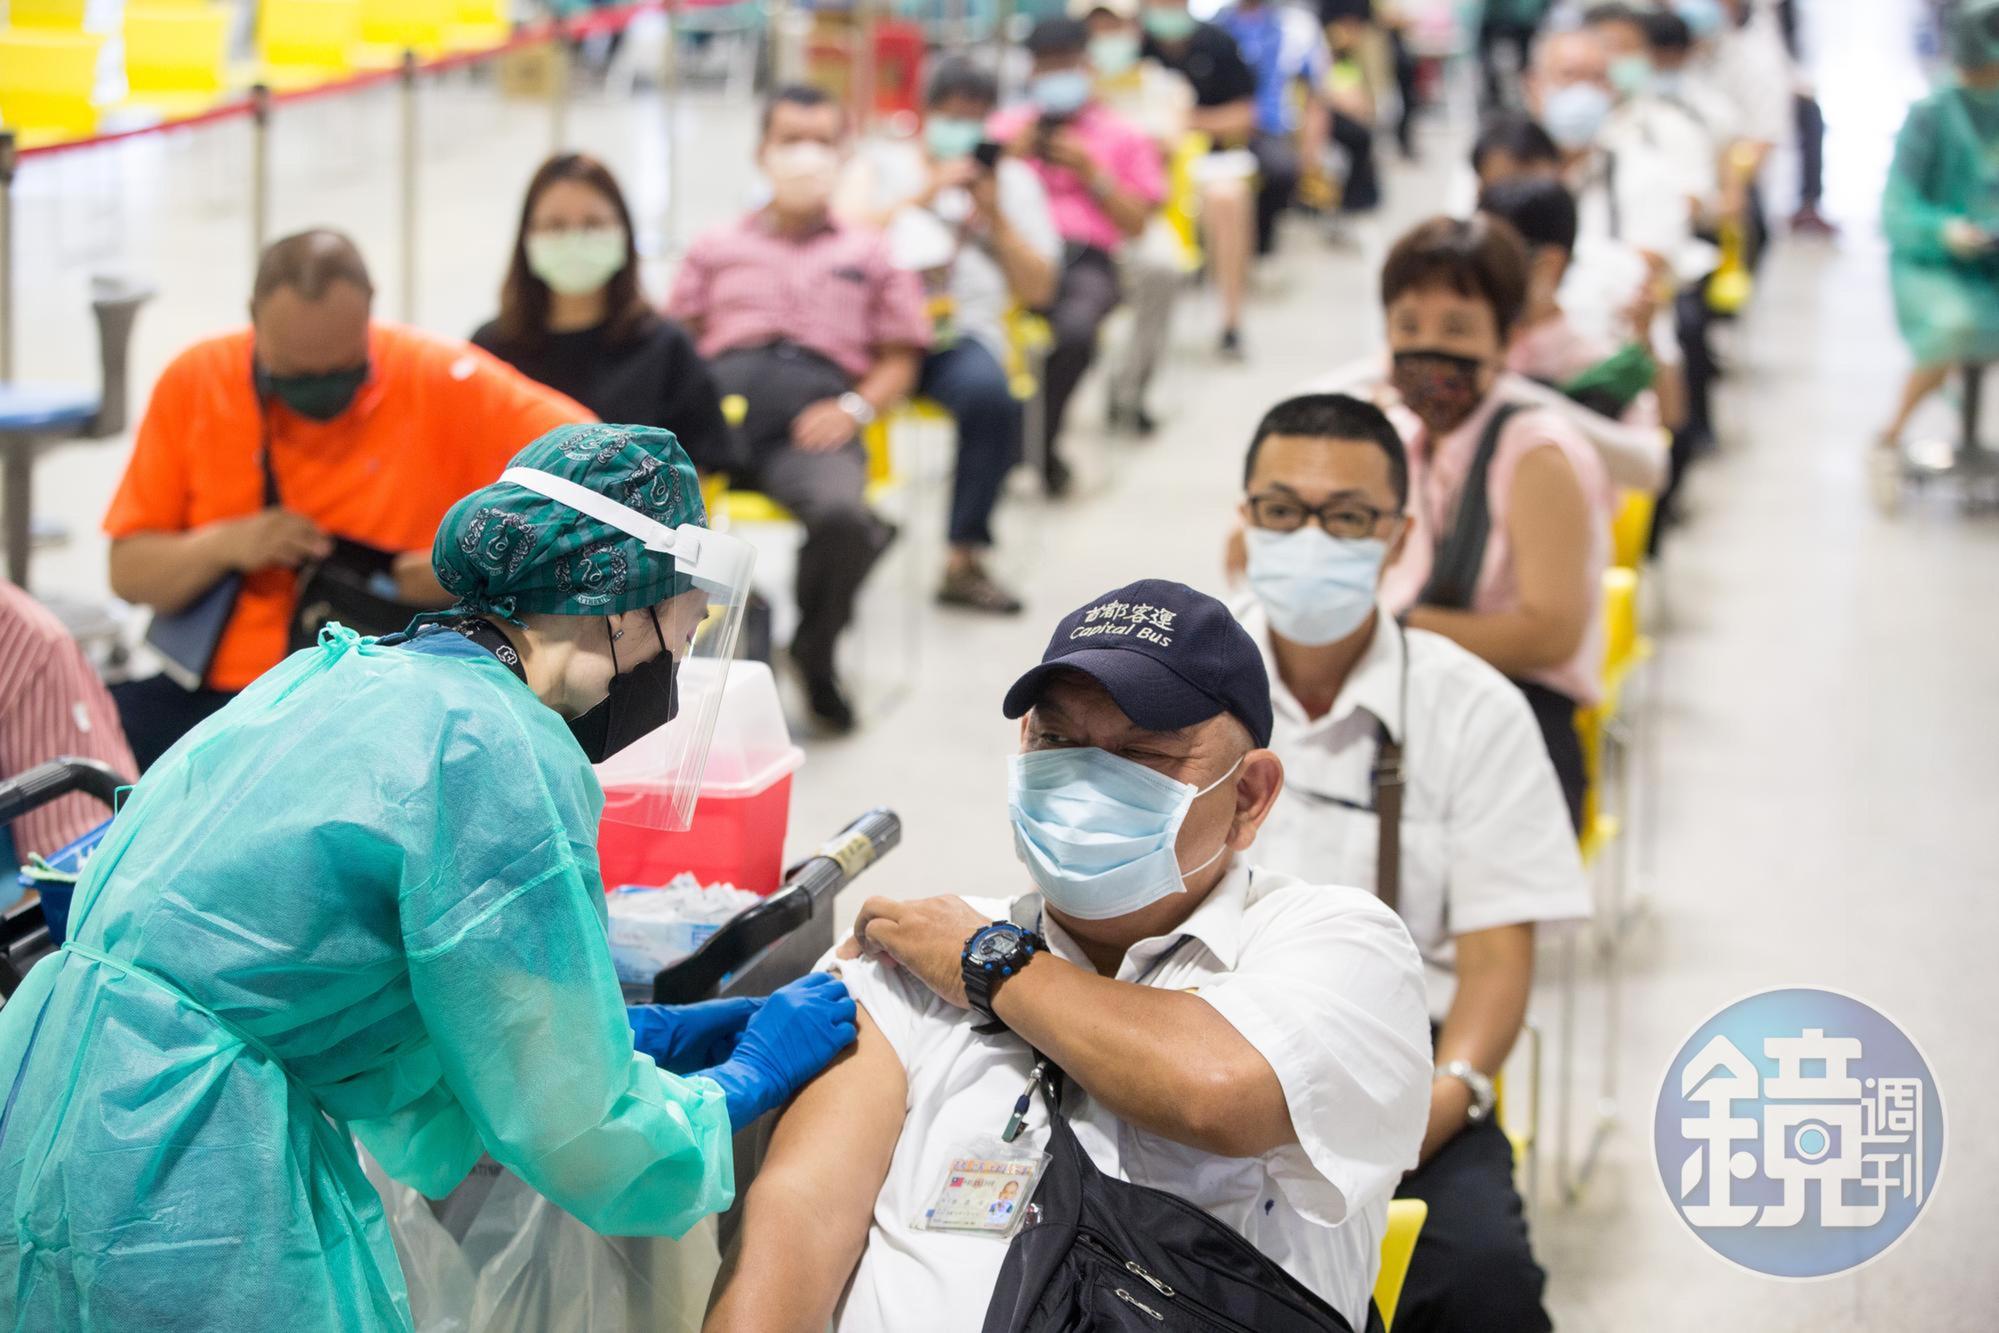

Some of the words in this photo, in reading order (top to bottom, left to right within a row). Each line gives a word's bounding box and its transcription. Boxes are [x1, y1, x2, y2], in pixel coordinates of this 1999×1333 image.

[1084, 600, 1176, 631] 首都客運
[1069, 621, 1136, 640] Capital
[1136, 627, 1172, 647] Bus
